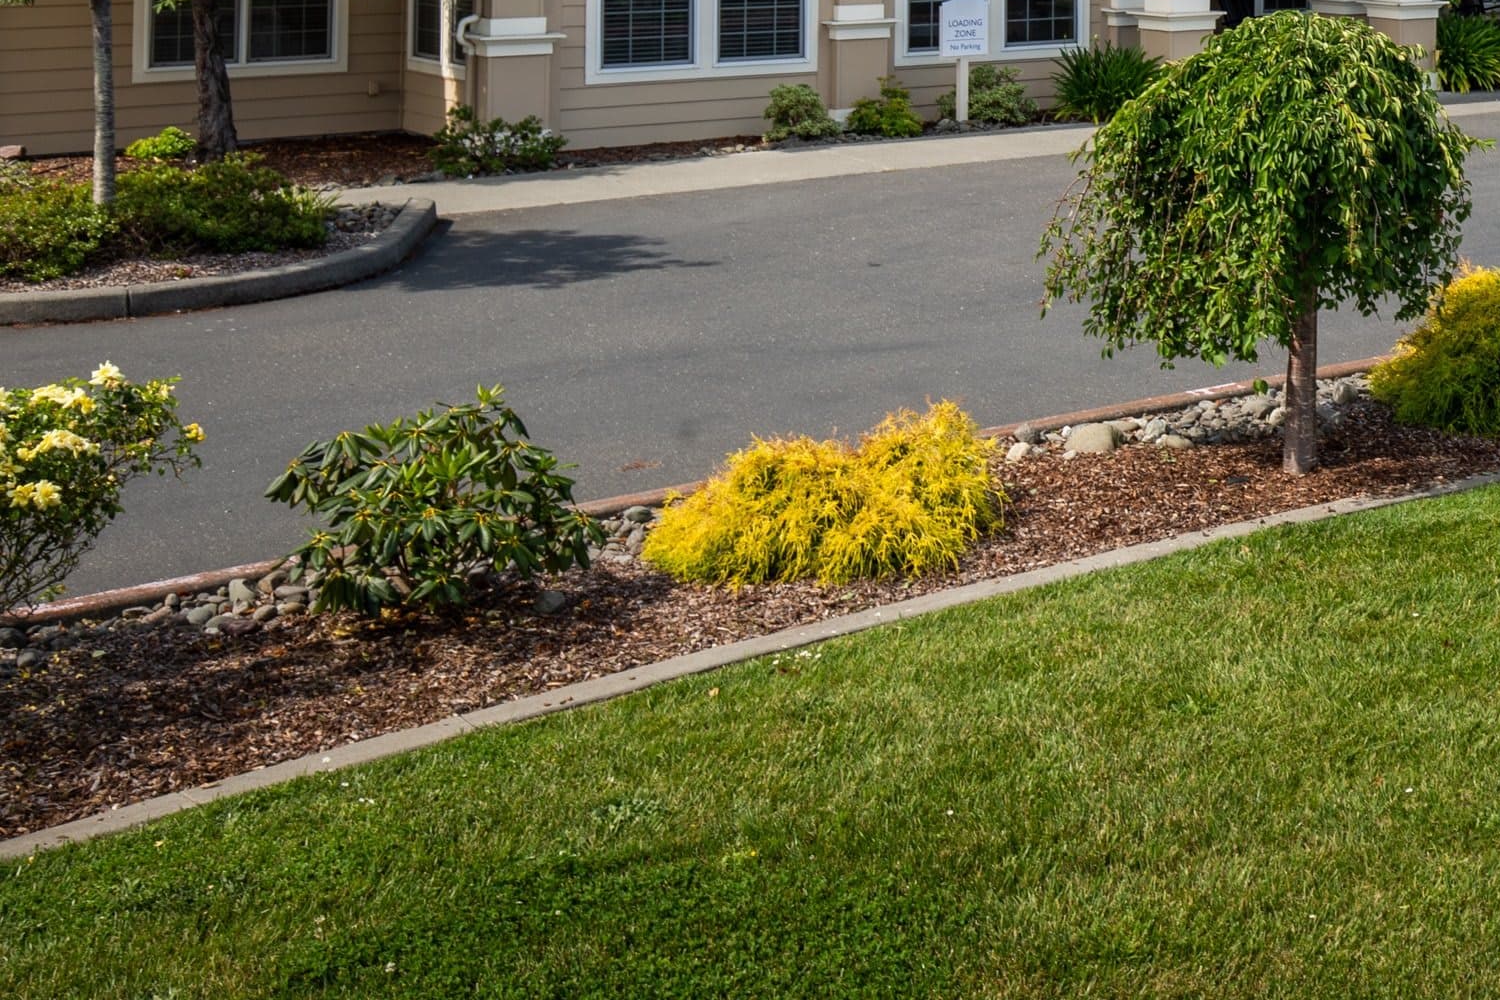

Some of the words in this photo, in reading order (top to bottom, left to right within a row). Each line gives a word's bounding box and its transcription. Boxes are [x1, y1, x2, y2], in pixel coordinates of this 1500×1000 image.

[948, 18, 983, 28] LOADING
[954, 29, 976, 38] ZONE
[961, 43, 981, 51] Parking
